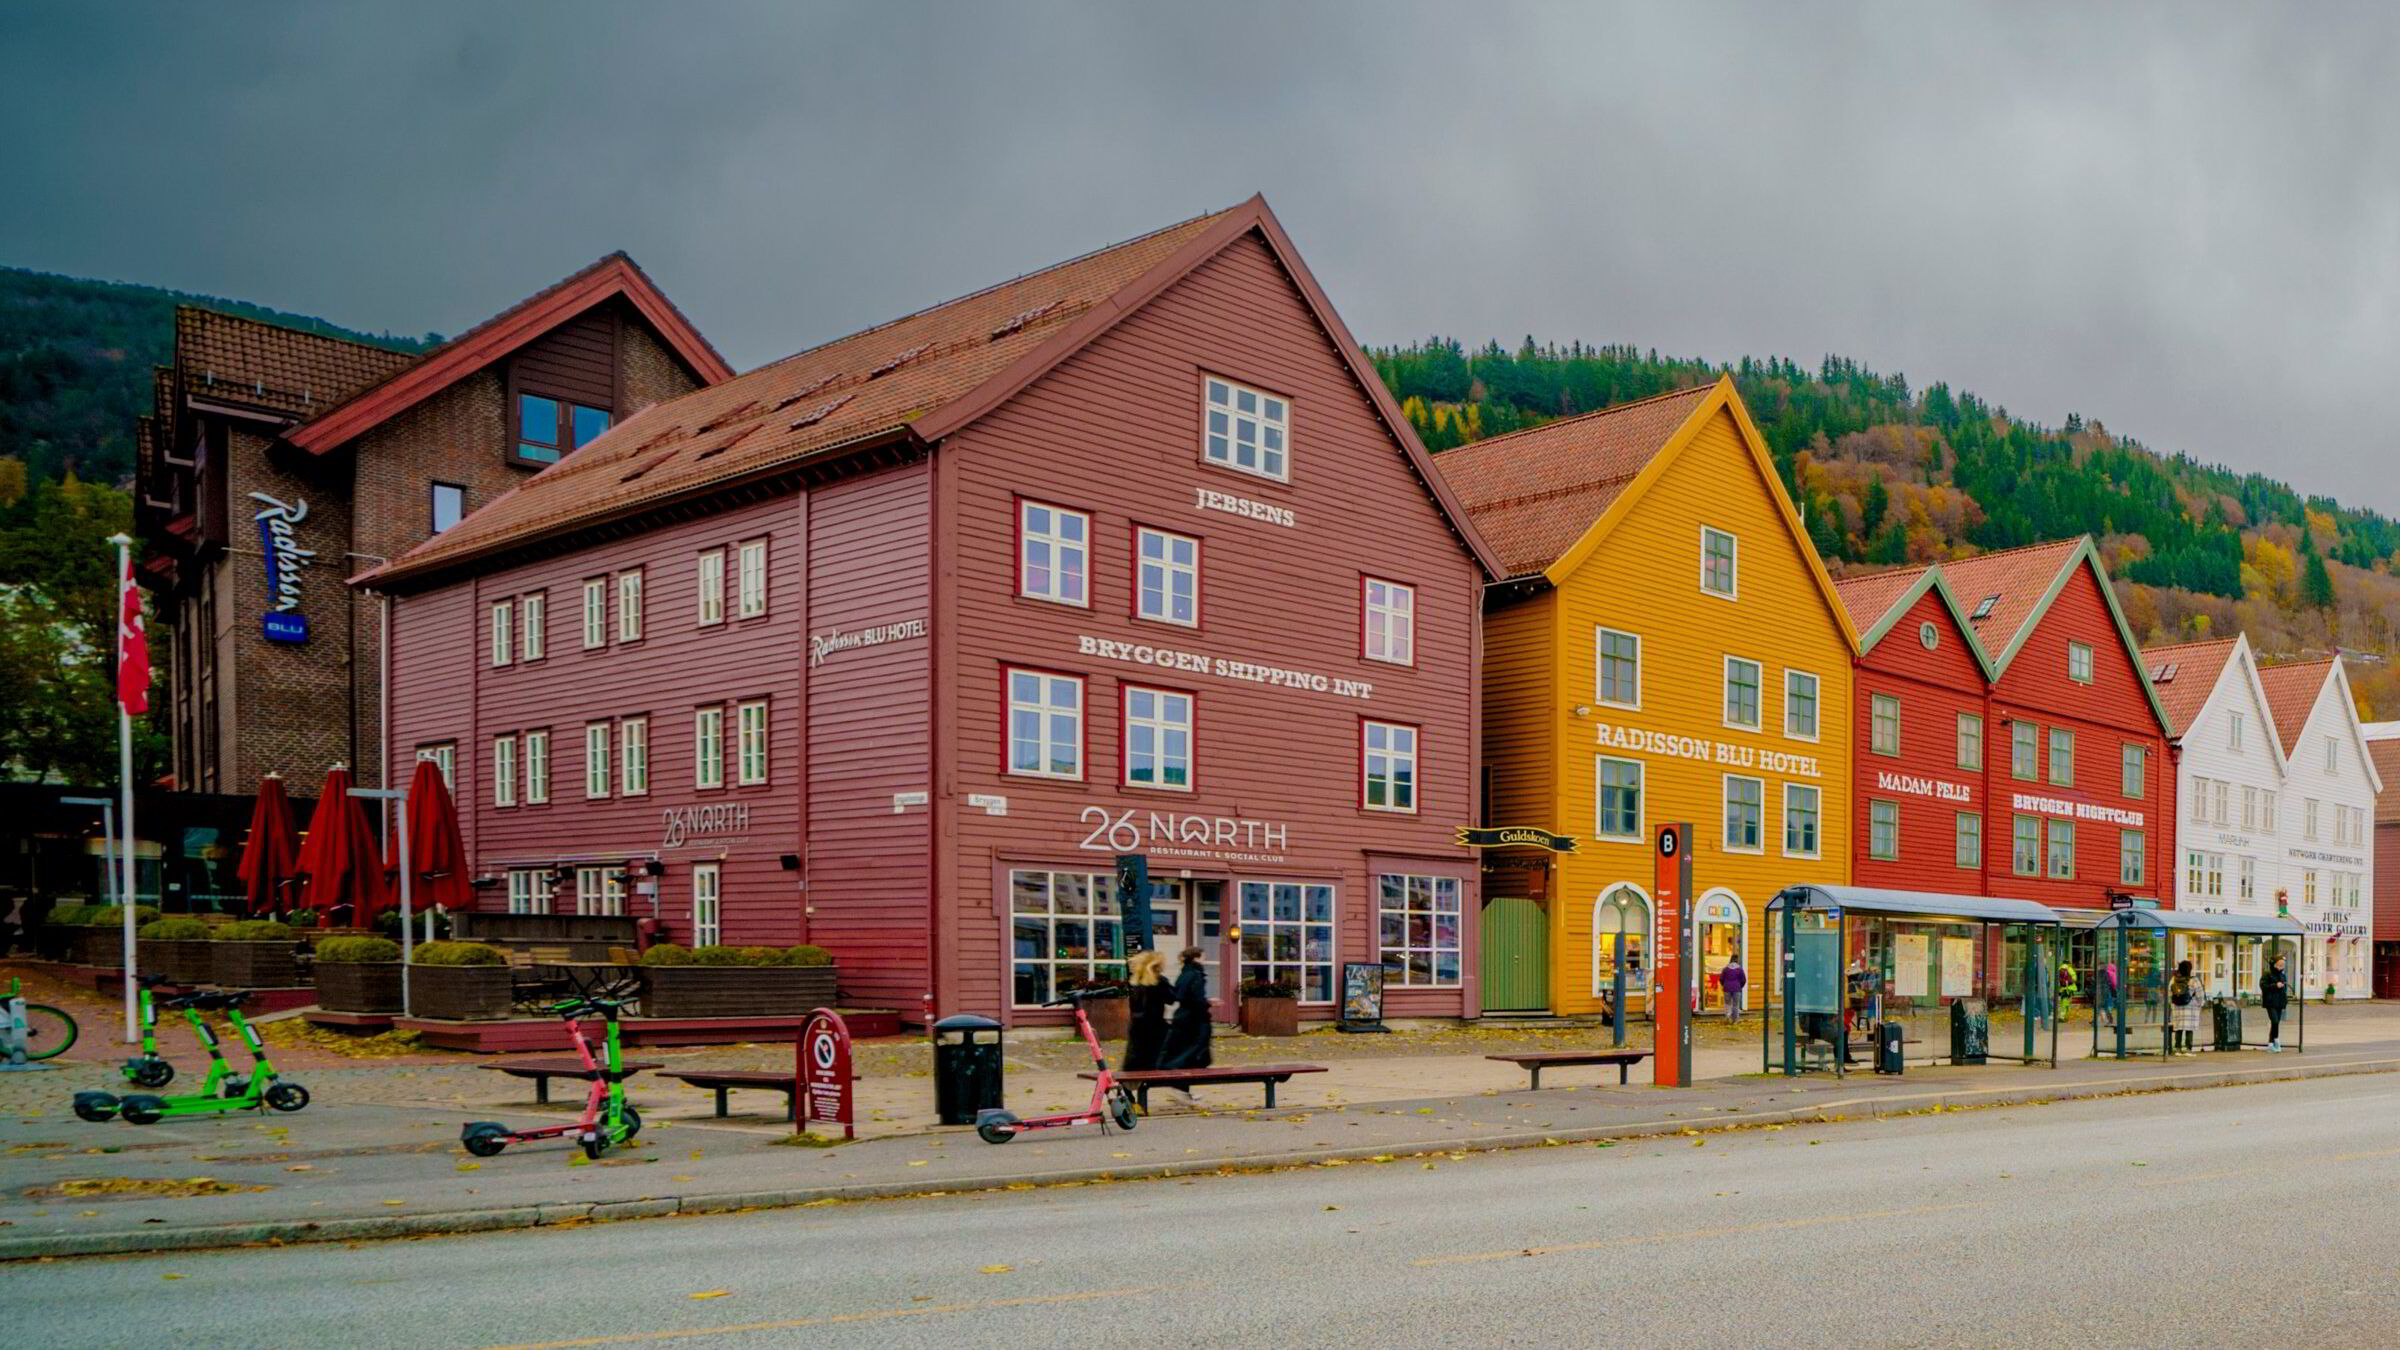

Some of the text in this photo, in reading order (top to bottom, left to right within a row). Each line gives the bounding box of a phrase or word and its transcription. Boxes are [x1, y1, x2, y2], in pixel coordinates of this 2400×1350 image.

[1195, 487, 1295, 527] JEBSENS
[248, 491, 317, 611] Radisson
[267, 622, 304, 634] BLU
[811, 619, 926, 669] Radisson BLU HOTEL
[1078, 635, 1373, 699] BRYGGEN SHIPPING INT
[1596, 723, 1822, 778] RADISSON BLU HOTEL
[1878, 771, 1971, 802] MADAM FELLE
[662, 802, 750, 848] 26 NORTH
[1079, 806, 1287, 852] 26 NORTH
[2013, 793, 2145, 827] BRYGGEN NIGHTCLUB
[1150, 846, 1212, 858] RESTAURANT
[1224, 852, 1259, 862] SOCIAL
[1261, 854, 1284, 863] CLUB
[1663, 834, 1674, 853] B
[2305, 922, 2368, 935] SILVER GALLERY
